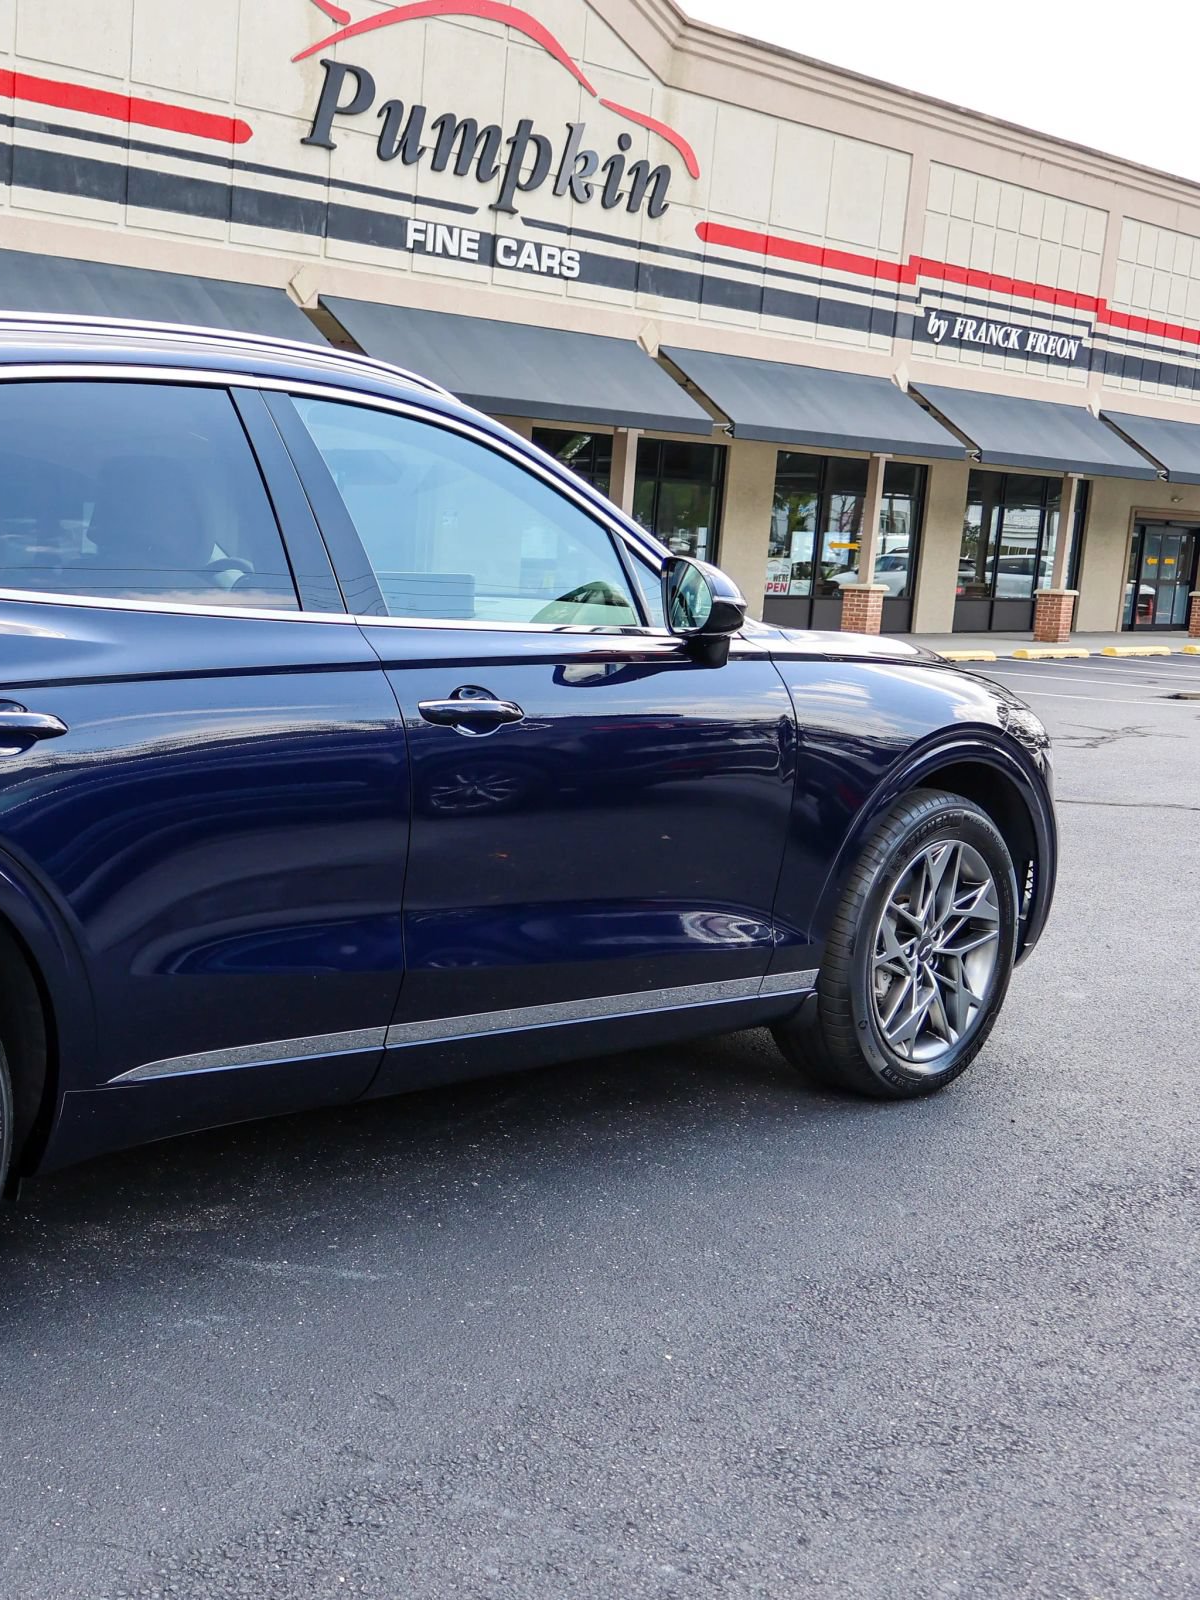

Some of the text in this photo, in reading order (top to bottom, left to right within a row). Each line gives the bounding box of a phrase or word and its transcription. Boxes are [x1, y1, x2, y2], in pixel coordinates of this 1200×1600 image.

[301, 58, 673, 219] Pumpkin
[406, 219, 581, 278] FINE CARS
[927, 311, 1080, 361] by FRANCK FREON
[765, 582, 788, 592] PEN
